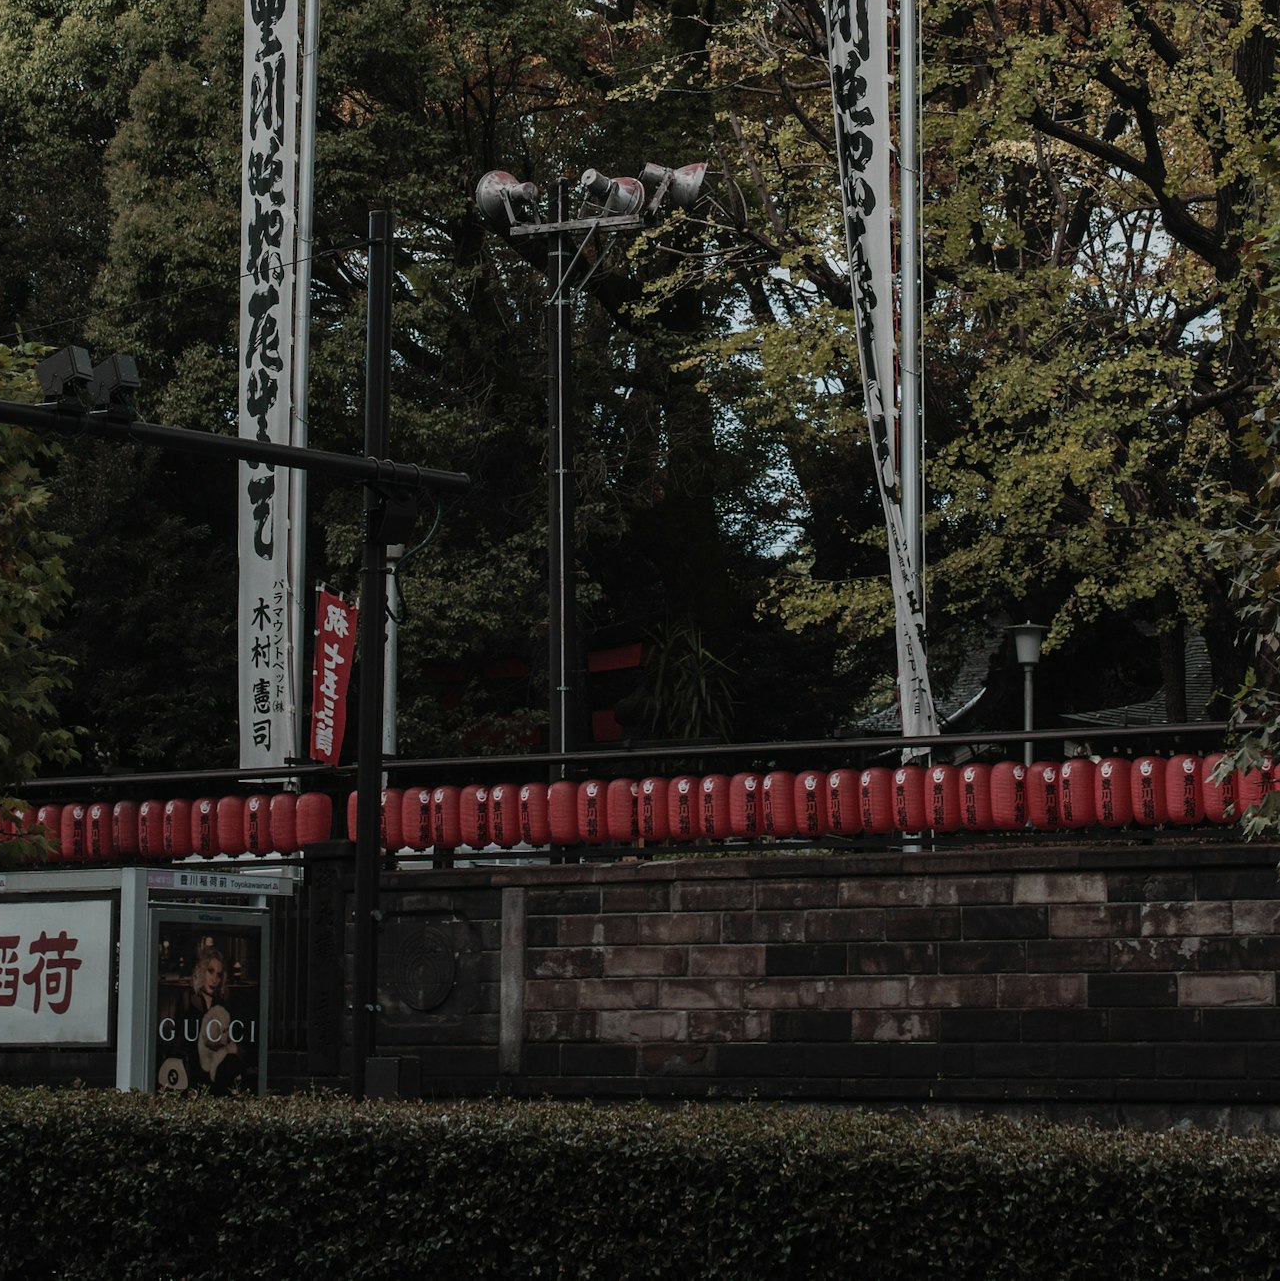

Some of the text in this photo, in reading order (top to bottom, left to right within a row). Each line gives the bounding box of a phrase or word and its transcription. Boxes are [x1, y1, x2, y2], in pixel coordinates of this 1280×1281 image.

[251, 597, 272, 752] 木村憲司
[159, 1018, 256, 1043] GUCCI
